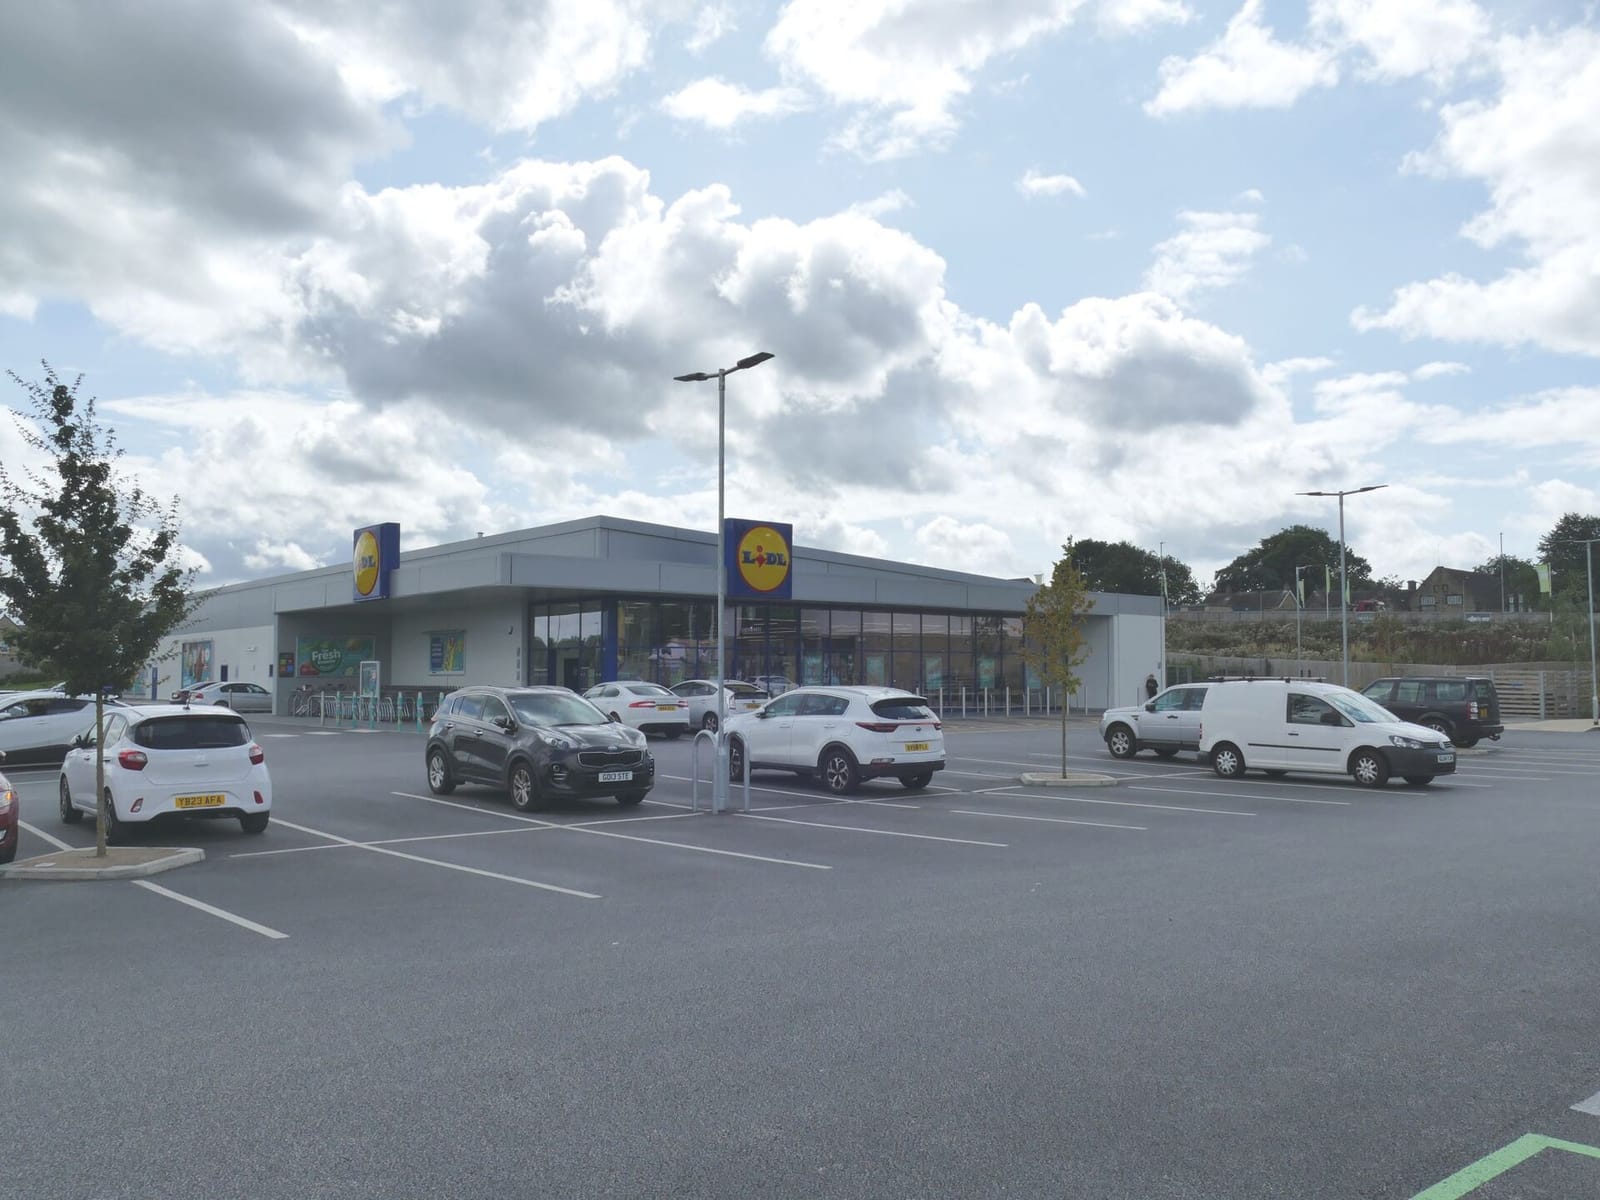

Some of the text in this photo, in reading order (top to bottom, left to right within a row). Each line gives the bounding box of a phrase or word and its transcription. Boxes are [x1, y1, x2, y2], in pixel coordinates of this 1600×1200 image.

[311, 648, 341, 660] Fresh
[178, 795, 222, 806] YB23 AFA
